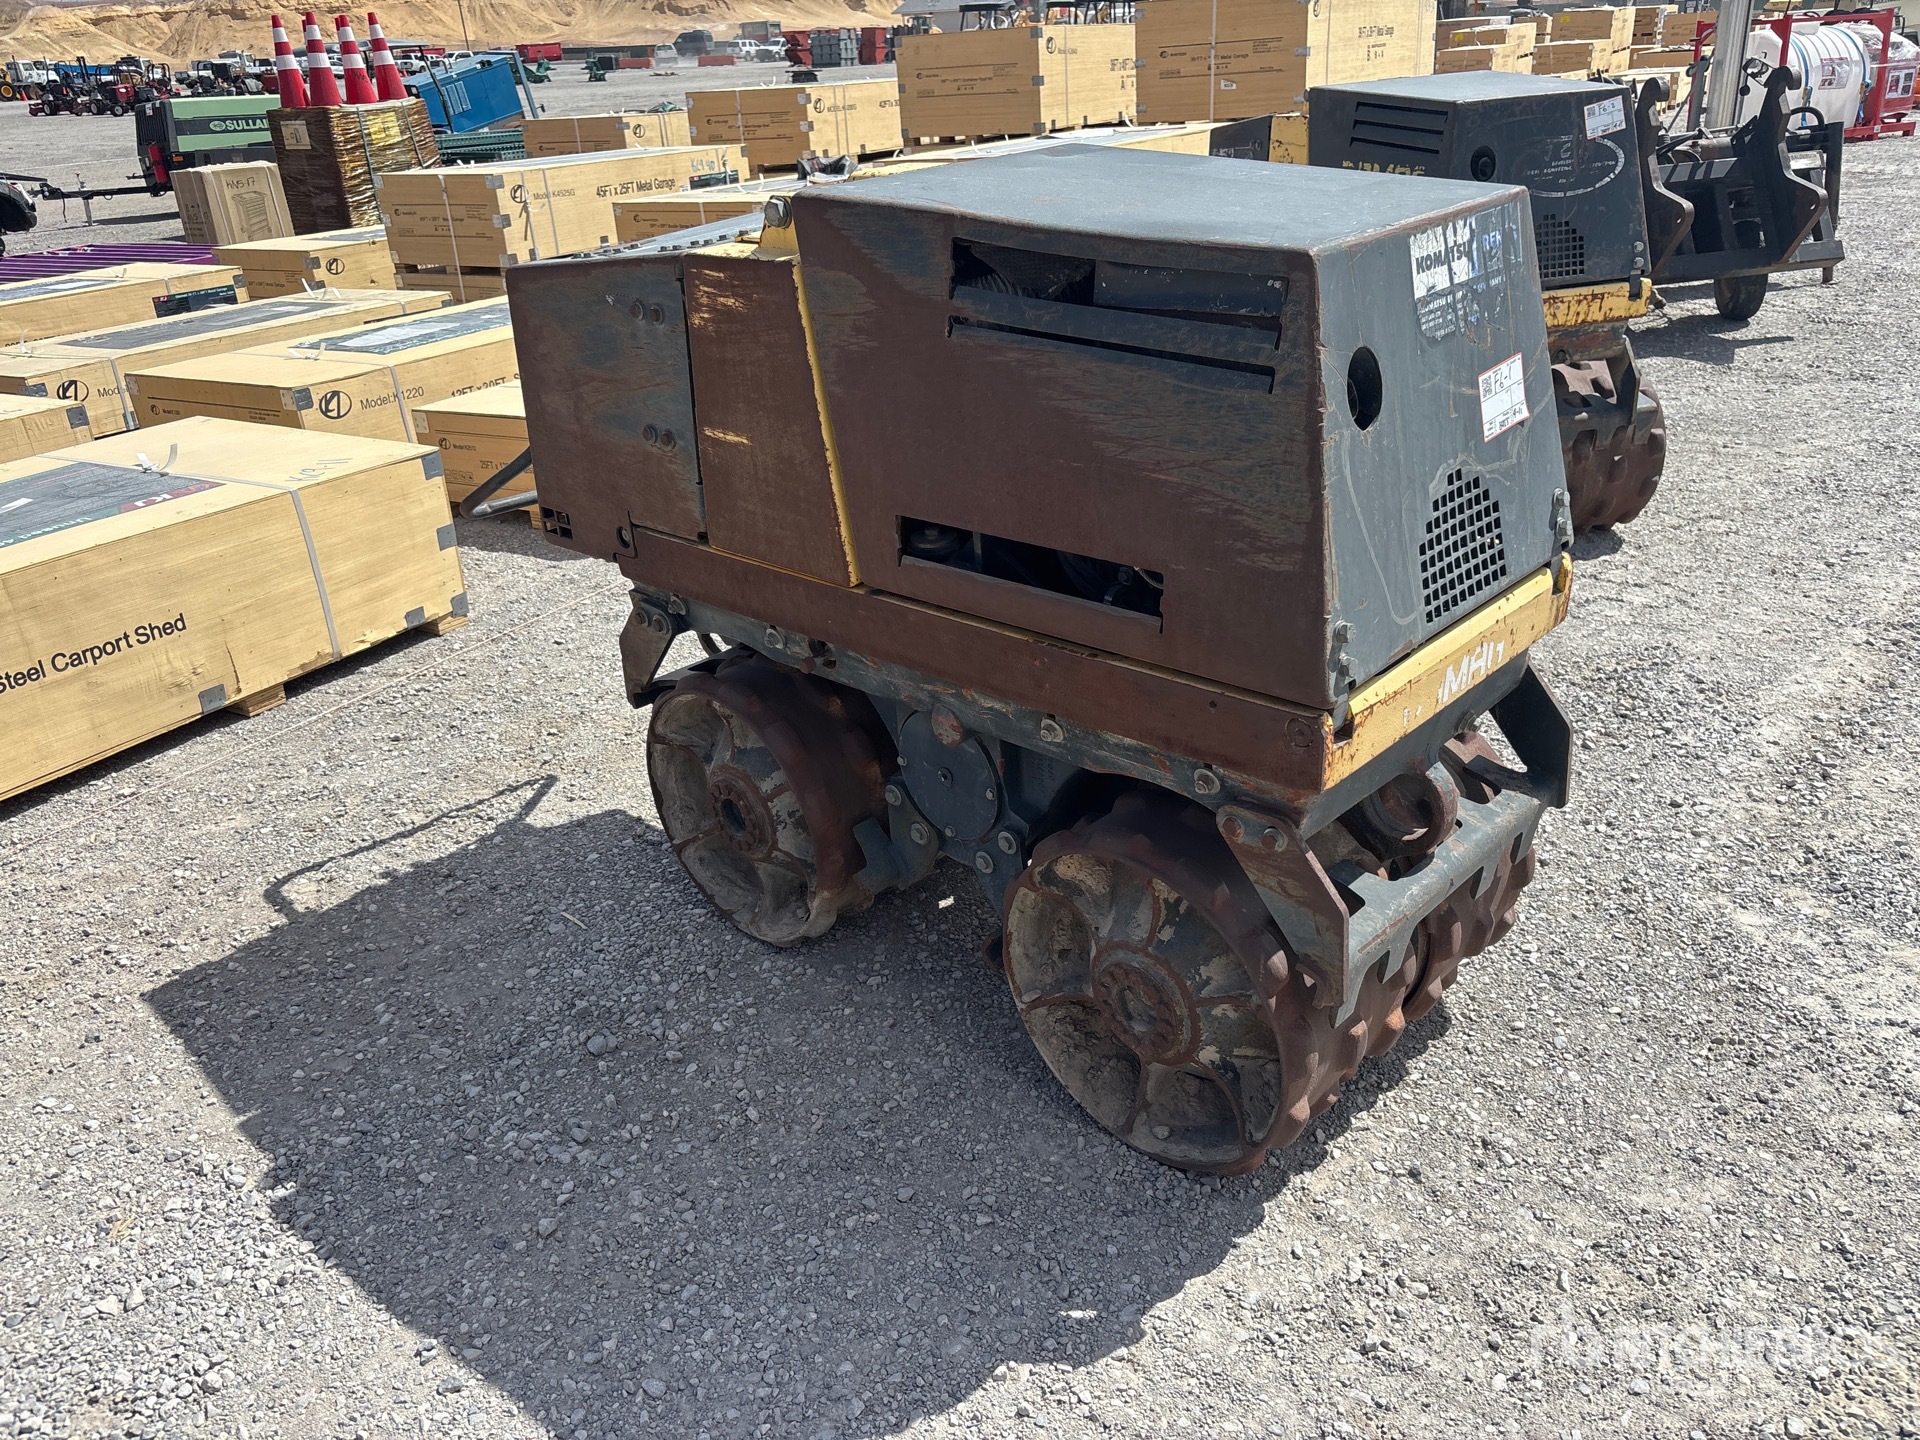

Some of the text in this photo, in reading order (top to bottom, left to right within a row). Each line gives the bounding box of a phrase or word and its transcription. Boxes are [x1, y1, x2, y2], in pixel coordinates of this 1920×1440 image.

[225, 118, 269, 130] SULLAI
[619, 181, 635, 195] 25FT
[635, 179, 653, 193] Metal
[653, 178, 676, 191] Garage
[51, 631, 134, 674] Carport
[134, 612, 188, 646] Shed
